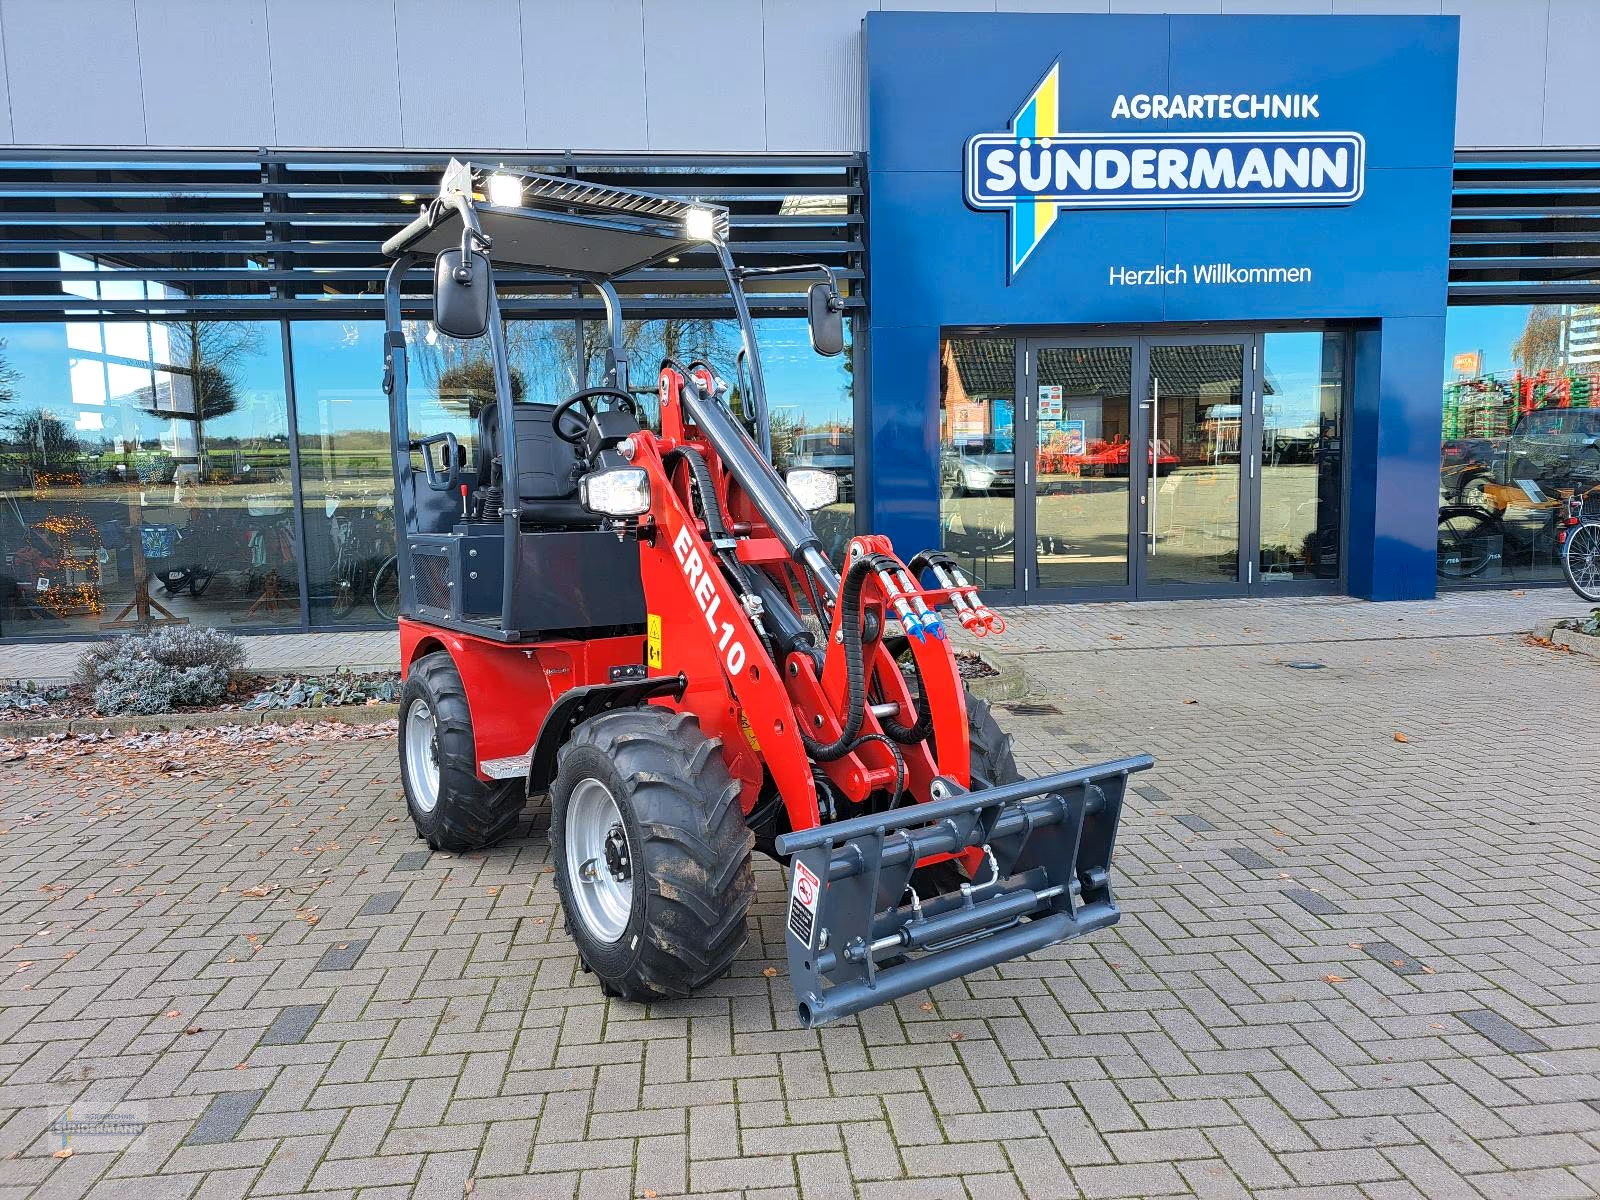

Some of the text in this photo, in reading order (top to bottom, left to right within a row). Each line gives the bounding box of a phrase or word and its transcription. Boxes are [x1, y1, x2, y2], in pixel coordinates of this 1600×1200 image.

[1111, 94, 1320, 119] AGRARTECHNIK
[985, 137, 1348, 191] SÜNDERMANN
[1109, 263, 1312, 286] Herzlich Willkommen
